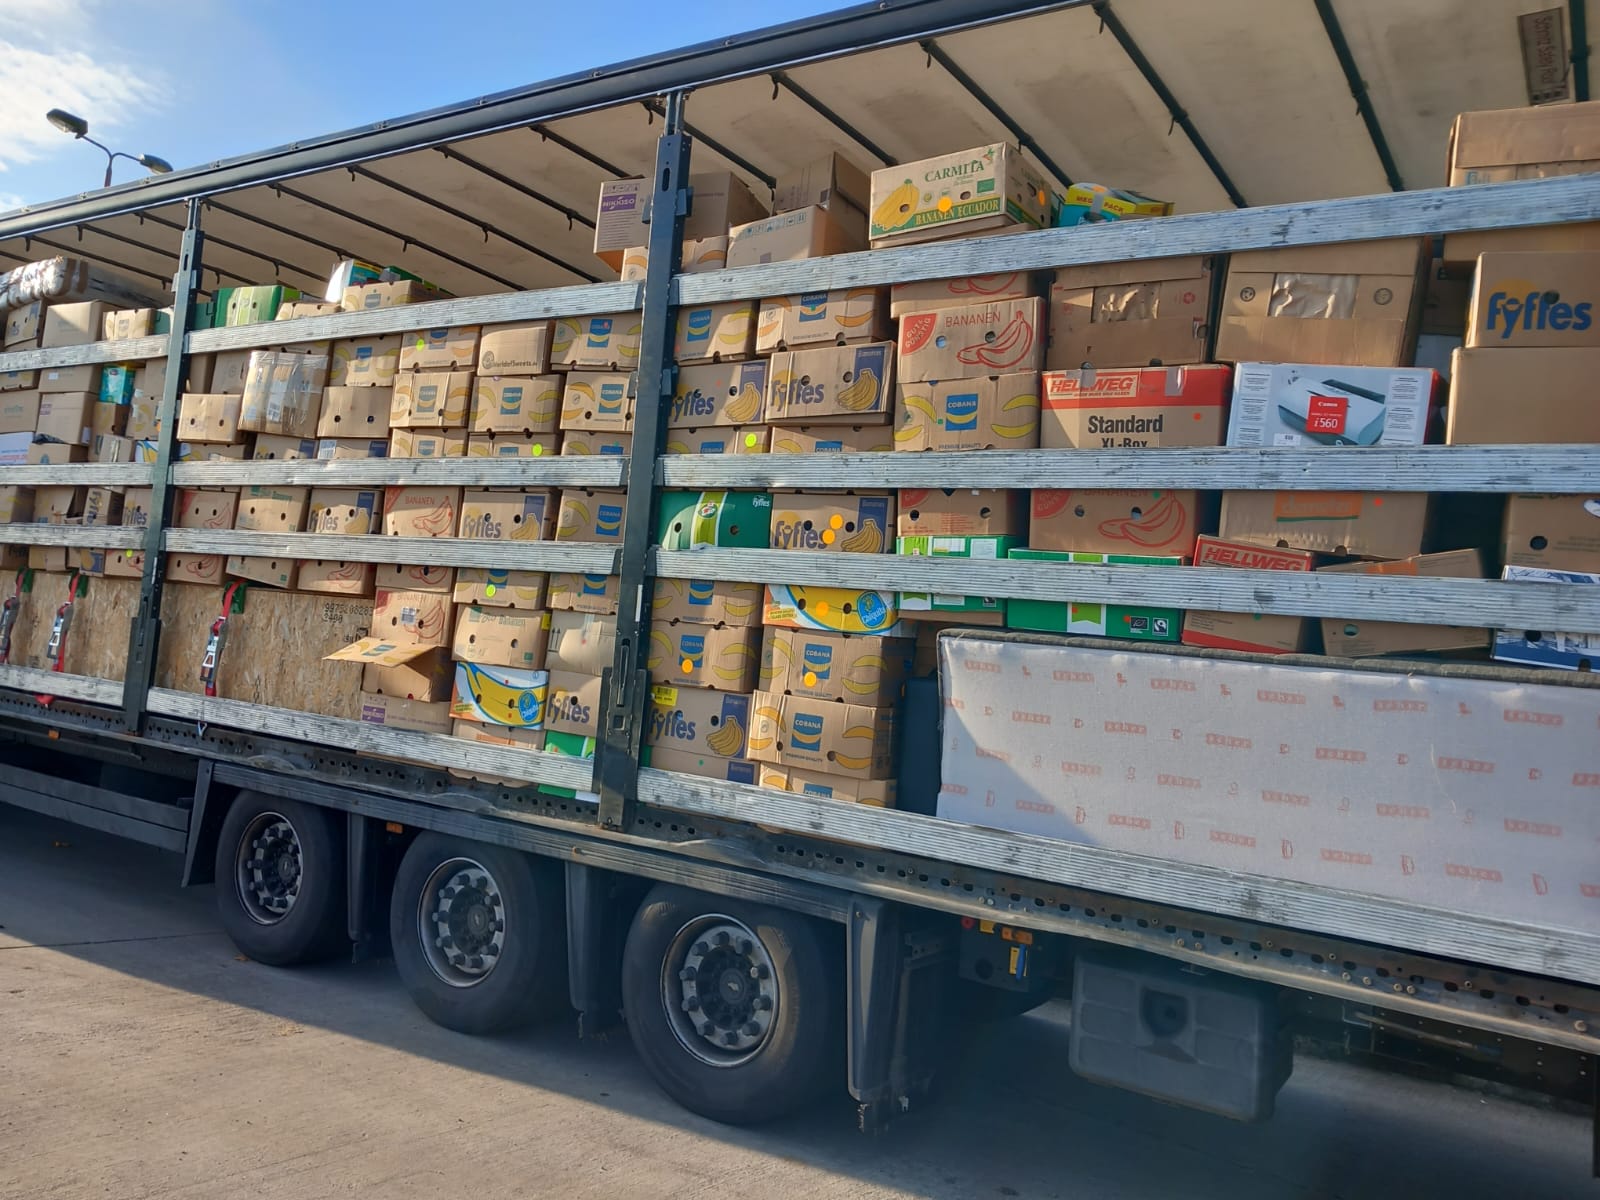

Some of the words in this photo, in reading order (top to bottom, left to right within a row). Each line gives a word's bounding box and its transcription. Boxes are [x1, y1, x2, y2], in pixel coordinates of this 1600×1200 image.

[925, 159, 985, 182] CARMITA
[957, 199, 1000, 218] ECUADOR
[1076, 195, 1092, 204] MEG
[802, 293, 827, 303] COBANA
[945, 312, 1001, 327] BANANEN
[1486, 291, 1593, 339] fyffes
[1050, 377, 1134, 393] HELWEG
[771, 377, 825, 412] fyffes
[948, 401, 977, 409] COBANA
[1088, 414, 1164, 434] Standard
[1314, 418, 1338, 429] i560
[405, 496, 435, 505] BANANEN
[752, 497, 770, 507] fyffes
[463, 514, 502, 539] fyffes
[774, 520, 828, 549] fyffes
[1204, 547, 1302, 570] HELLWEG
[862, 606, 887, 624] Chiquita
[806, 650, 831, 658] COBANA
[547, 693, 591, 723] fyffes
[649, 708, 697, 741] fyffes
[794, 719, 822, 729] COBANA
